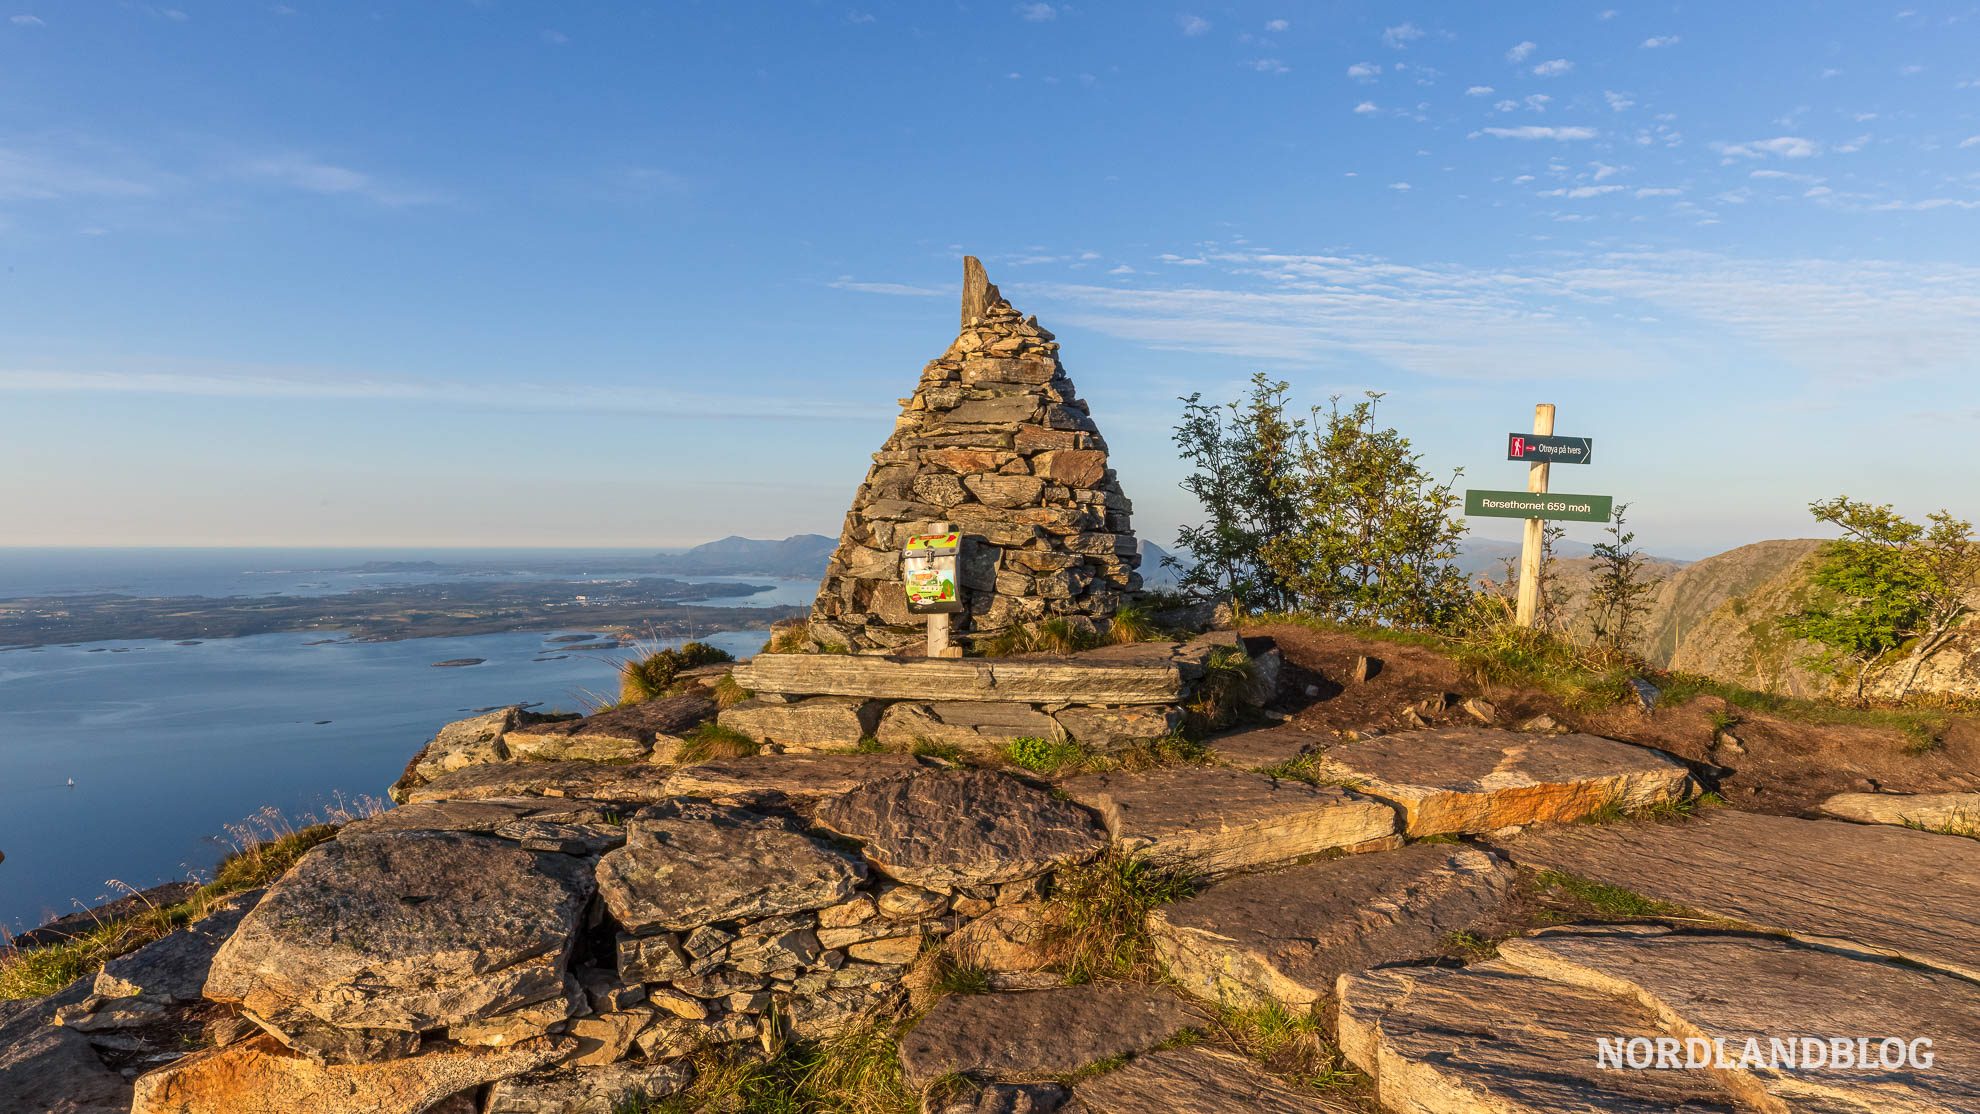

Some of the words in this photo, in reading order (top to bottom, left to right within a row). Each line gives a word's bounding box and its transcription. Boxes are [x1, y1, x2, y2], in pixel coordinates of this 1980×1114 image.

[1539, 443, 1557, 454] Otrøya
[1559, 445, 1567, 455] på
[1567, 446, 1581, 455] tvers
[1482, 499, 1544, 510] Rørsethornet
[1547, 502, 1566, 511] 659
[1569, 503, 1591, 513] moh
